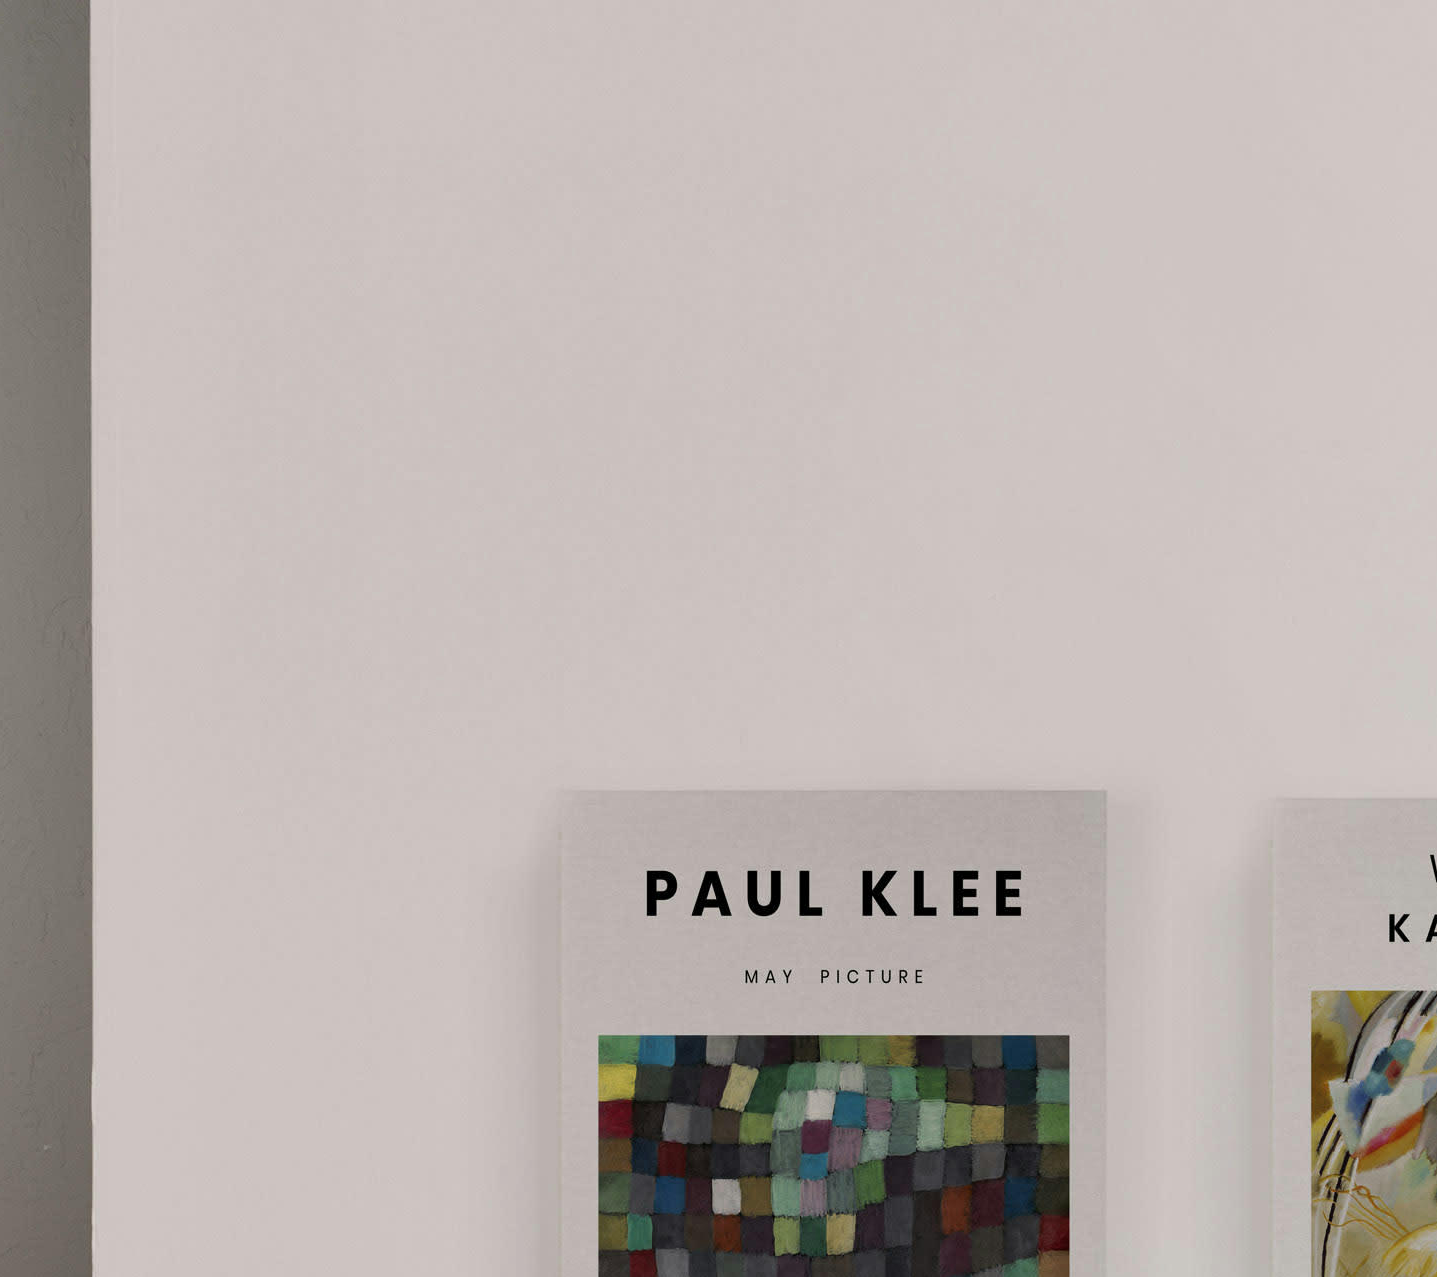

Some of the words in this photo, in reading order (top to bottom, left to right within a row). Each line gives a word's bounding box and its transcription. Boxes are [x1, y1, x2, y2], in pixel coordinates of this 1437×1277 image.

[646, 869, 823, 917] PAUL
[861, 869, 1022, 917] KLEE
[744, 969, 793, 984] MAY
[820, 969, 924, 985] PICTURE
